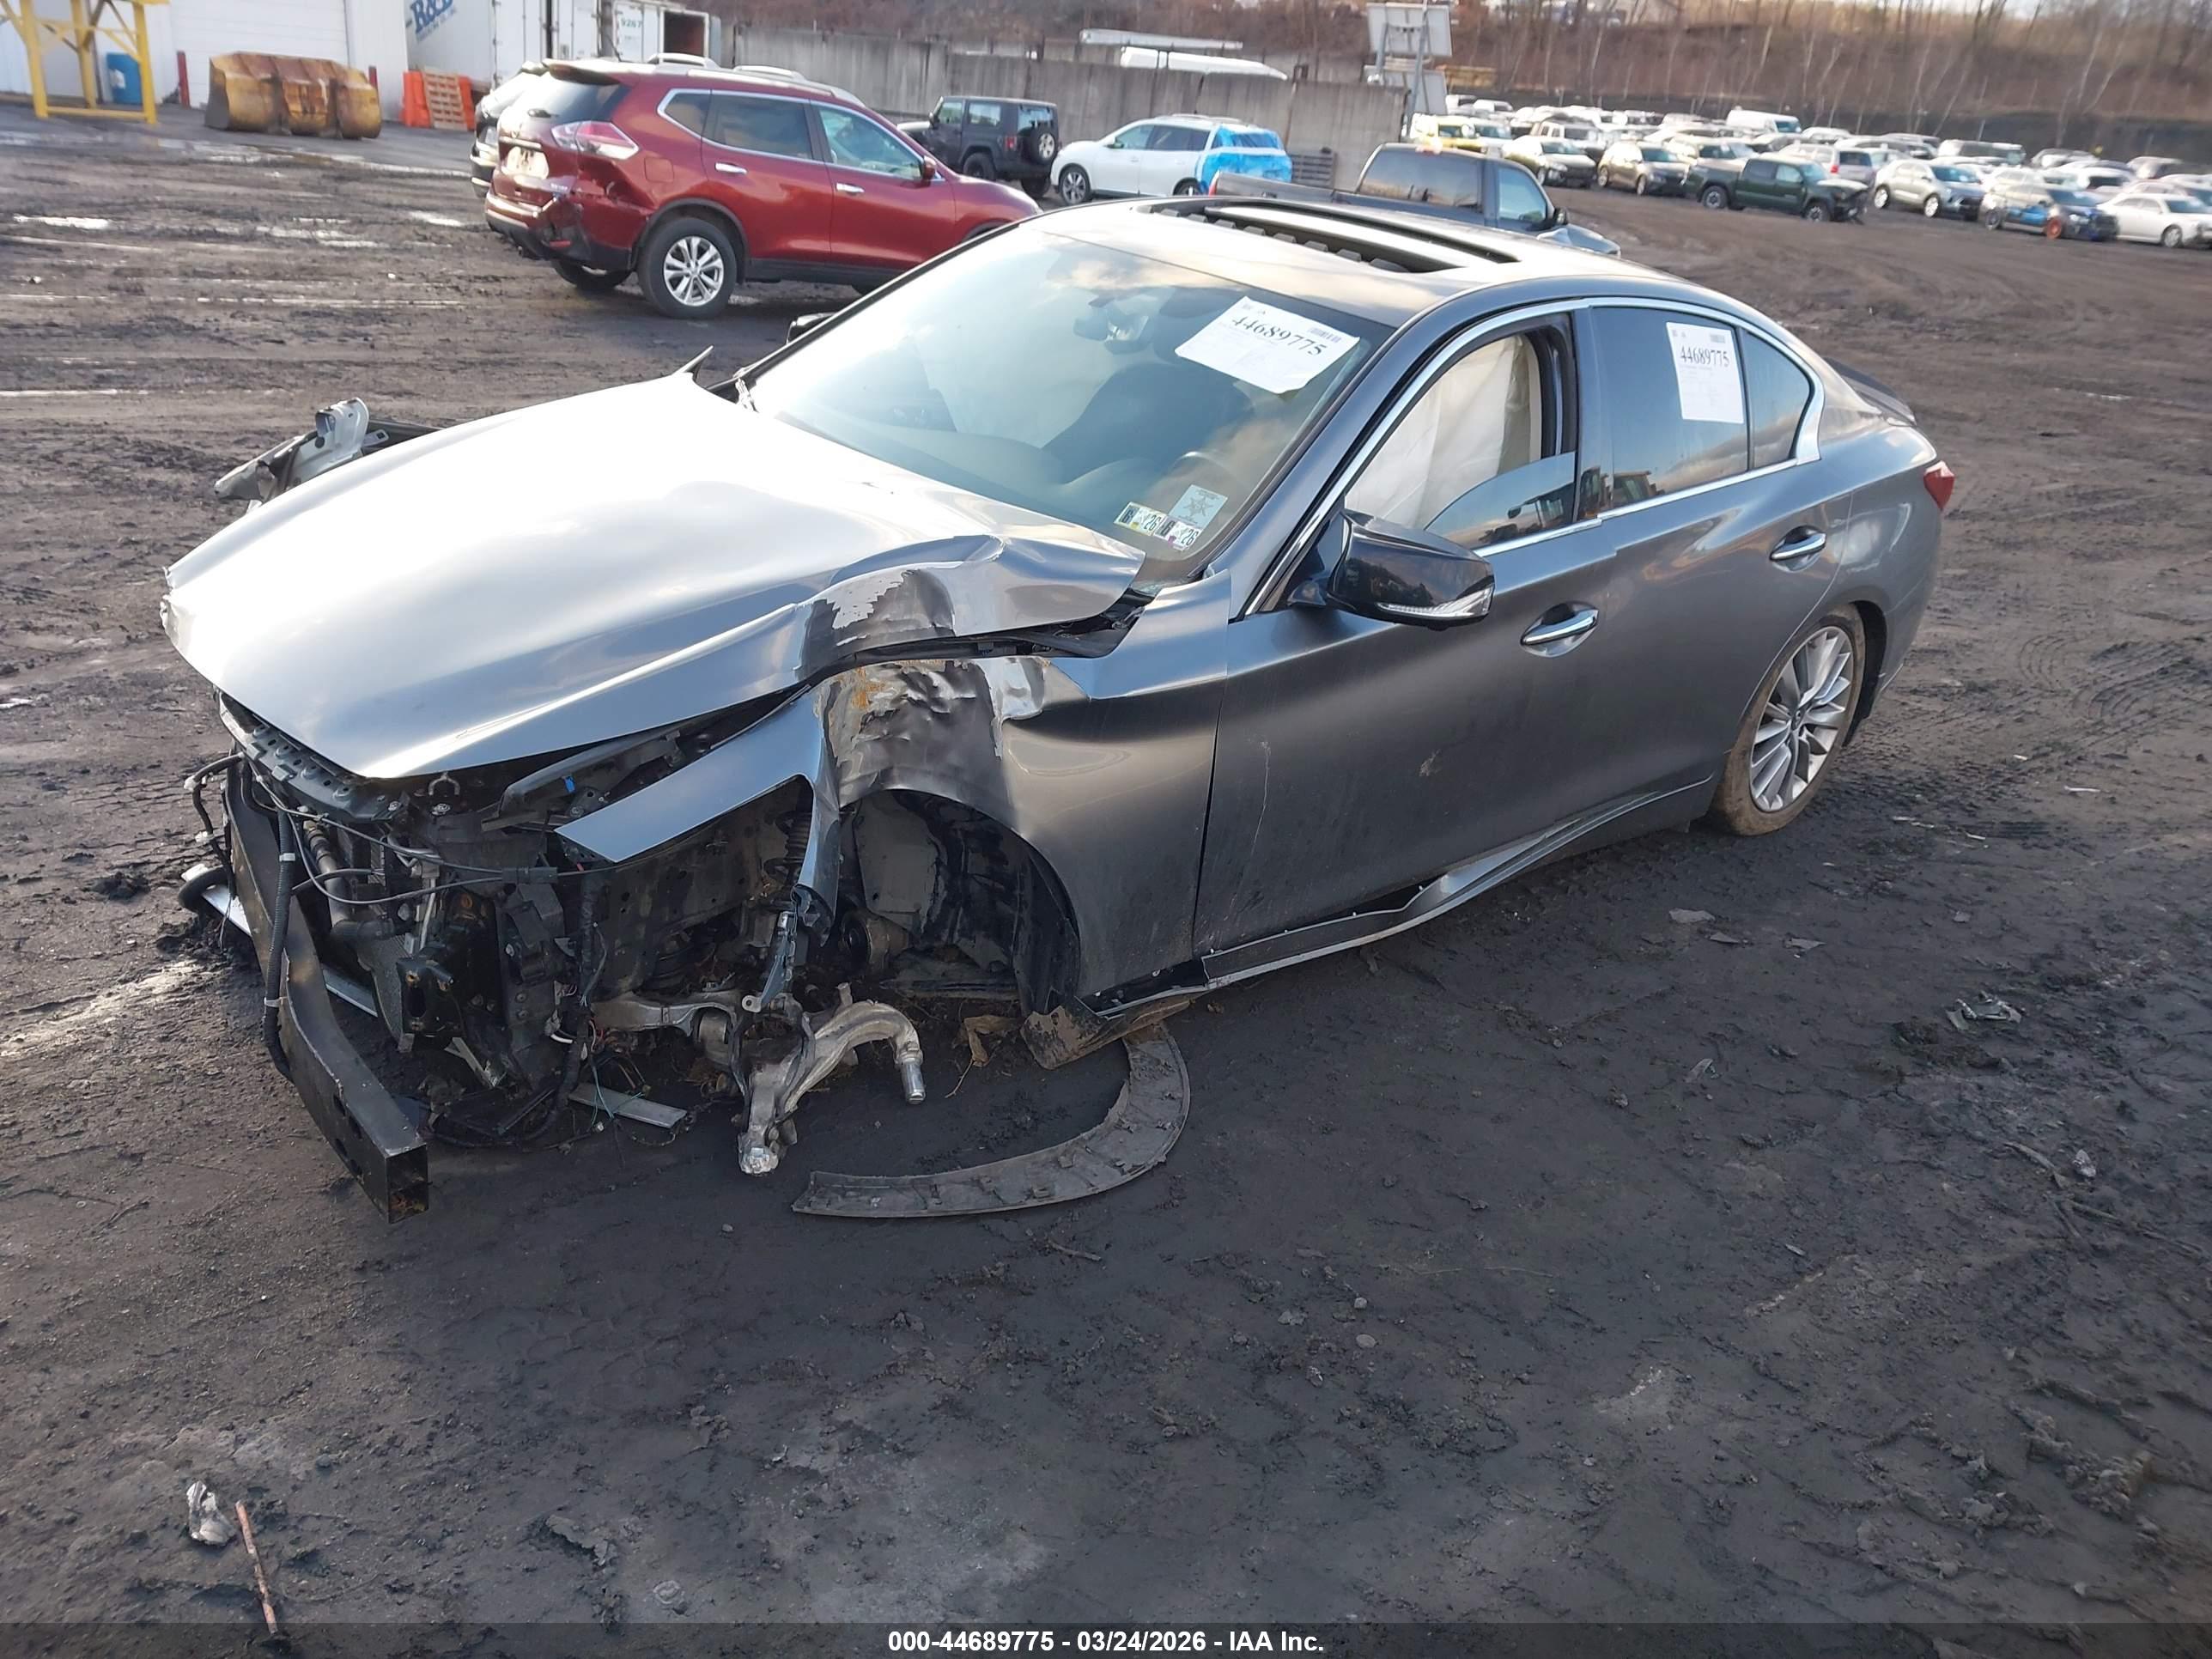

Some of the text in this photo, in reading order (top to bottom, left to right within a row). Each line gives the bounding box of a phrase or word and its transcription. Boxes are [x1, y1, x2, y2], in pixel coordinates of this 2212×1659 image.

[1232, 316, 1328, 356] 44689775
[1680, 345, 1730, 368] 44689775
[1144, 514, 1161, 531] 26
[1181, 528, 1200, 547] 26
